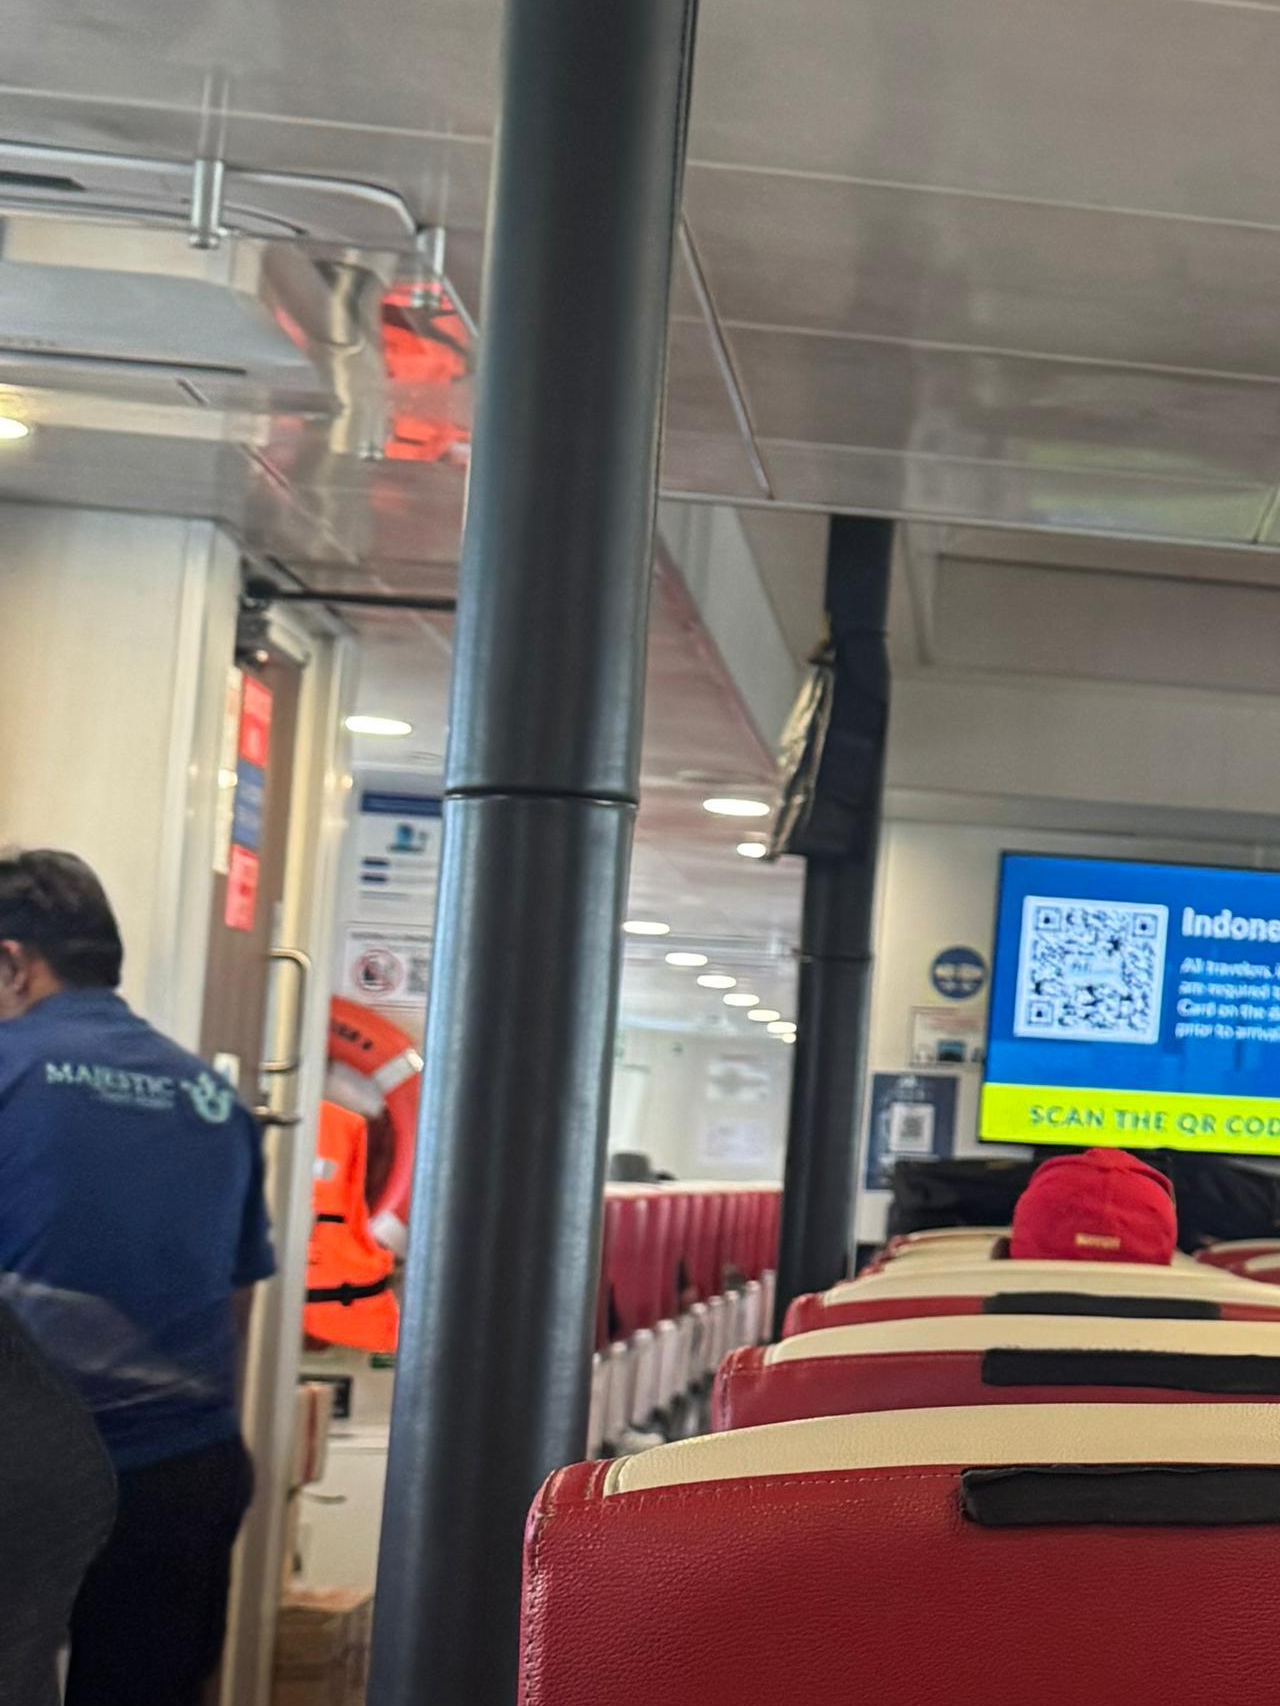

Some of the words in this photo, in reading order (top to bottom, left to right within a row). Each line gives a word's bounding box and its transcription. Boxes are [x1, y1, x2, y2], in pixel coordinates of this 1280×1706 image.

[1029, 1105, 1103, 1129] SCAN
[1115, 1108, 1167, 1132] THE
[1176, 1112, 1216, 1135] QR
